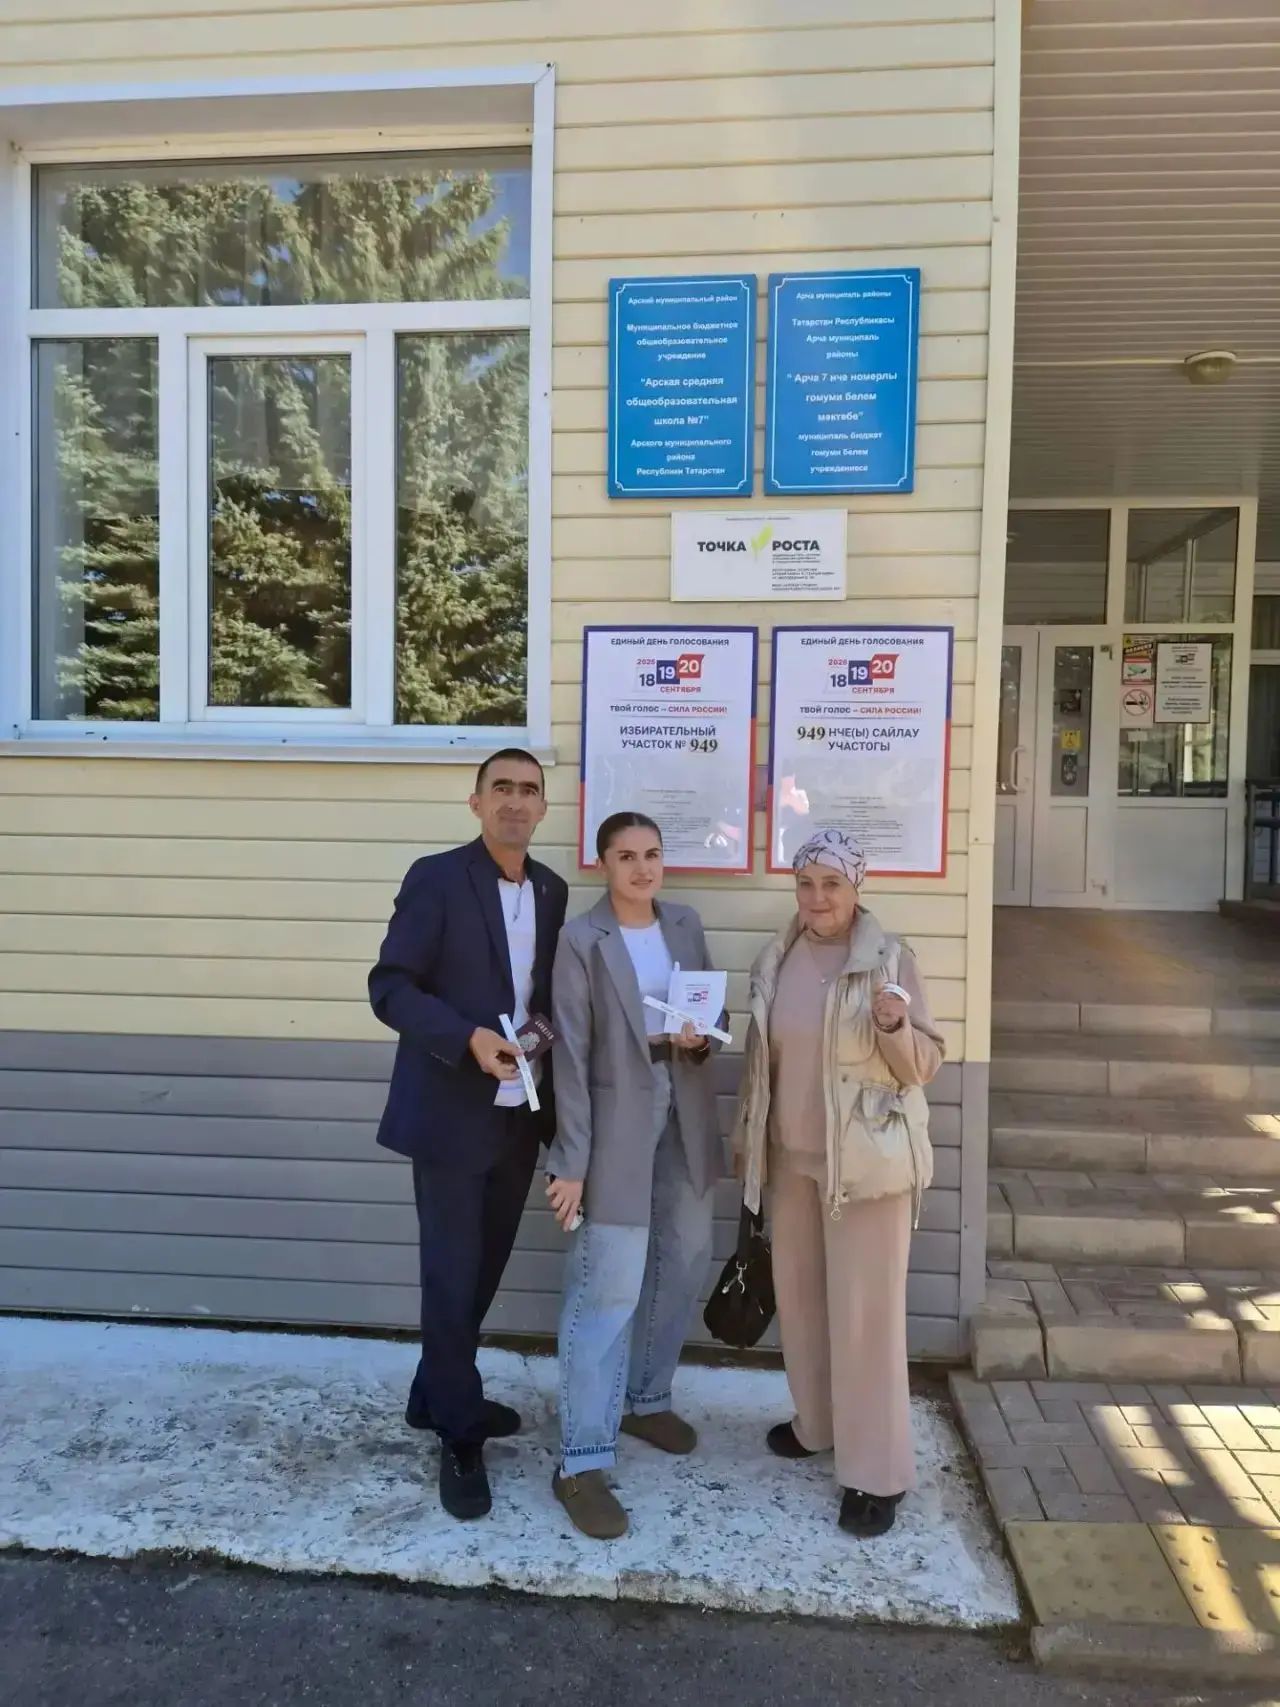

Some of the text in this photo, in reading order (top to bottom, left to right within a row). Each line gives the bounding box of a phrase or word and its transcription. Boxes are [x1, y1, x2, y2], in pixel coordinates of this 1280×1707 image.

[792, 316, 895, 328] Татарстан Республикасы
[806, 334, 880, 344] Арча муниципаль
[683, 377, 724, 388] средняя
[794, 373, 820, 384] Арча
[822, 372, 828, 381] 7
[830, 374, 848, 382] нче
[850, 372, 898, 382] номерлы
[626, 396, 738, 408] общеобразовательная
[806, 392, 877, 403] гомуми белем
[654, 416, 686, 425] школа
[630, 438, 732, 448] Арского муниципального
[636, 466, 726, 477] Республики Татарстан
[697, 540, 820, 552] ТОЧКА РОСТА
[611, 637, 645, 646] ЕДИНЫЙ
[646, 638, 668, 646] ДЕНЬ
[800, 636, 836, 646] ЕДИНЫЙ
[838, 638, 861, 646] ДЕНЬ
[640, 660, 700, 687] 18 19 20
[830, 660, 894, 688] 18 19 20
[610, 704, 631, 712] ТВОЙ
[632, 705, 660, 713] ГОЛОС
[800, 704, 822, 714] ТВОЙ
[620, 725, 716, 736] ИЗБИРАТЕЛЬНЫЙ
[797, 726, 920, 740] 949 НЧЕ(Ы) САЙЛАУ
[621, 738, 718, 752] УЧАСТОК № 949
[828, 741, 890, 752] УЧАСТОГЫ
